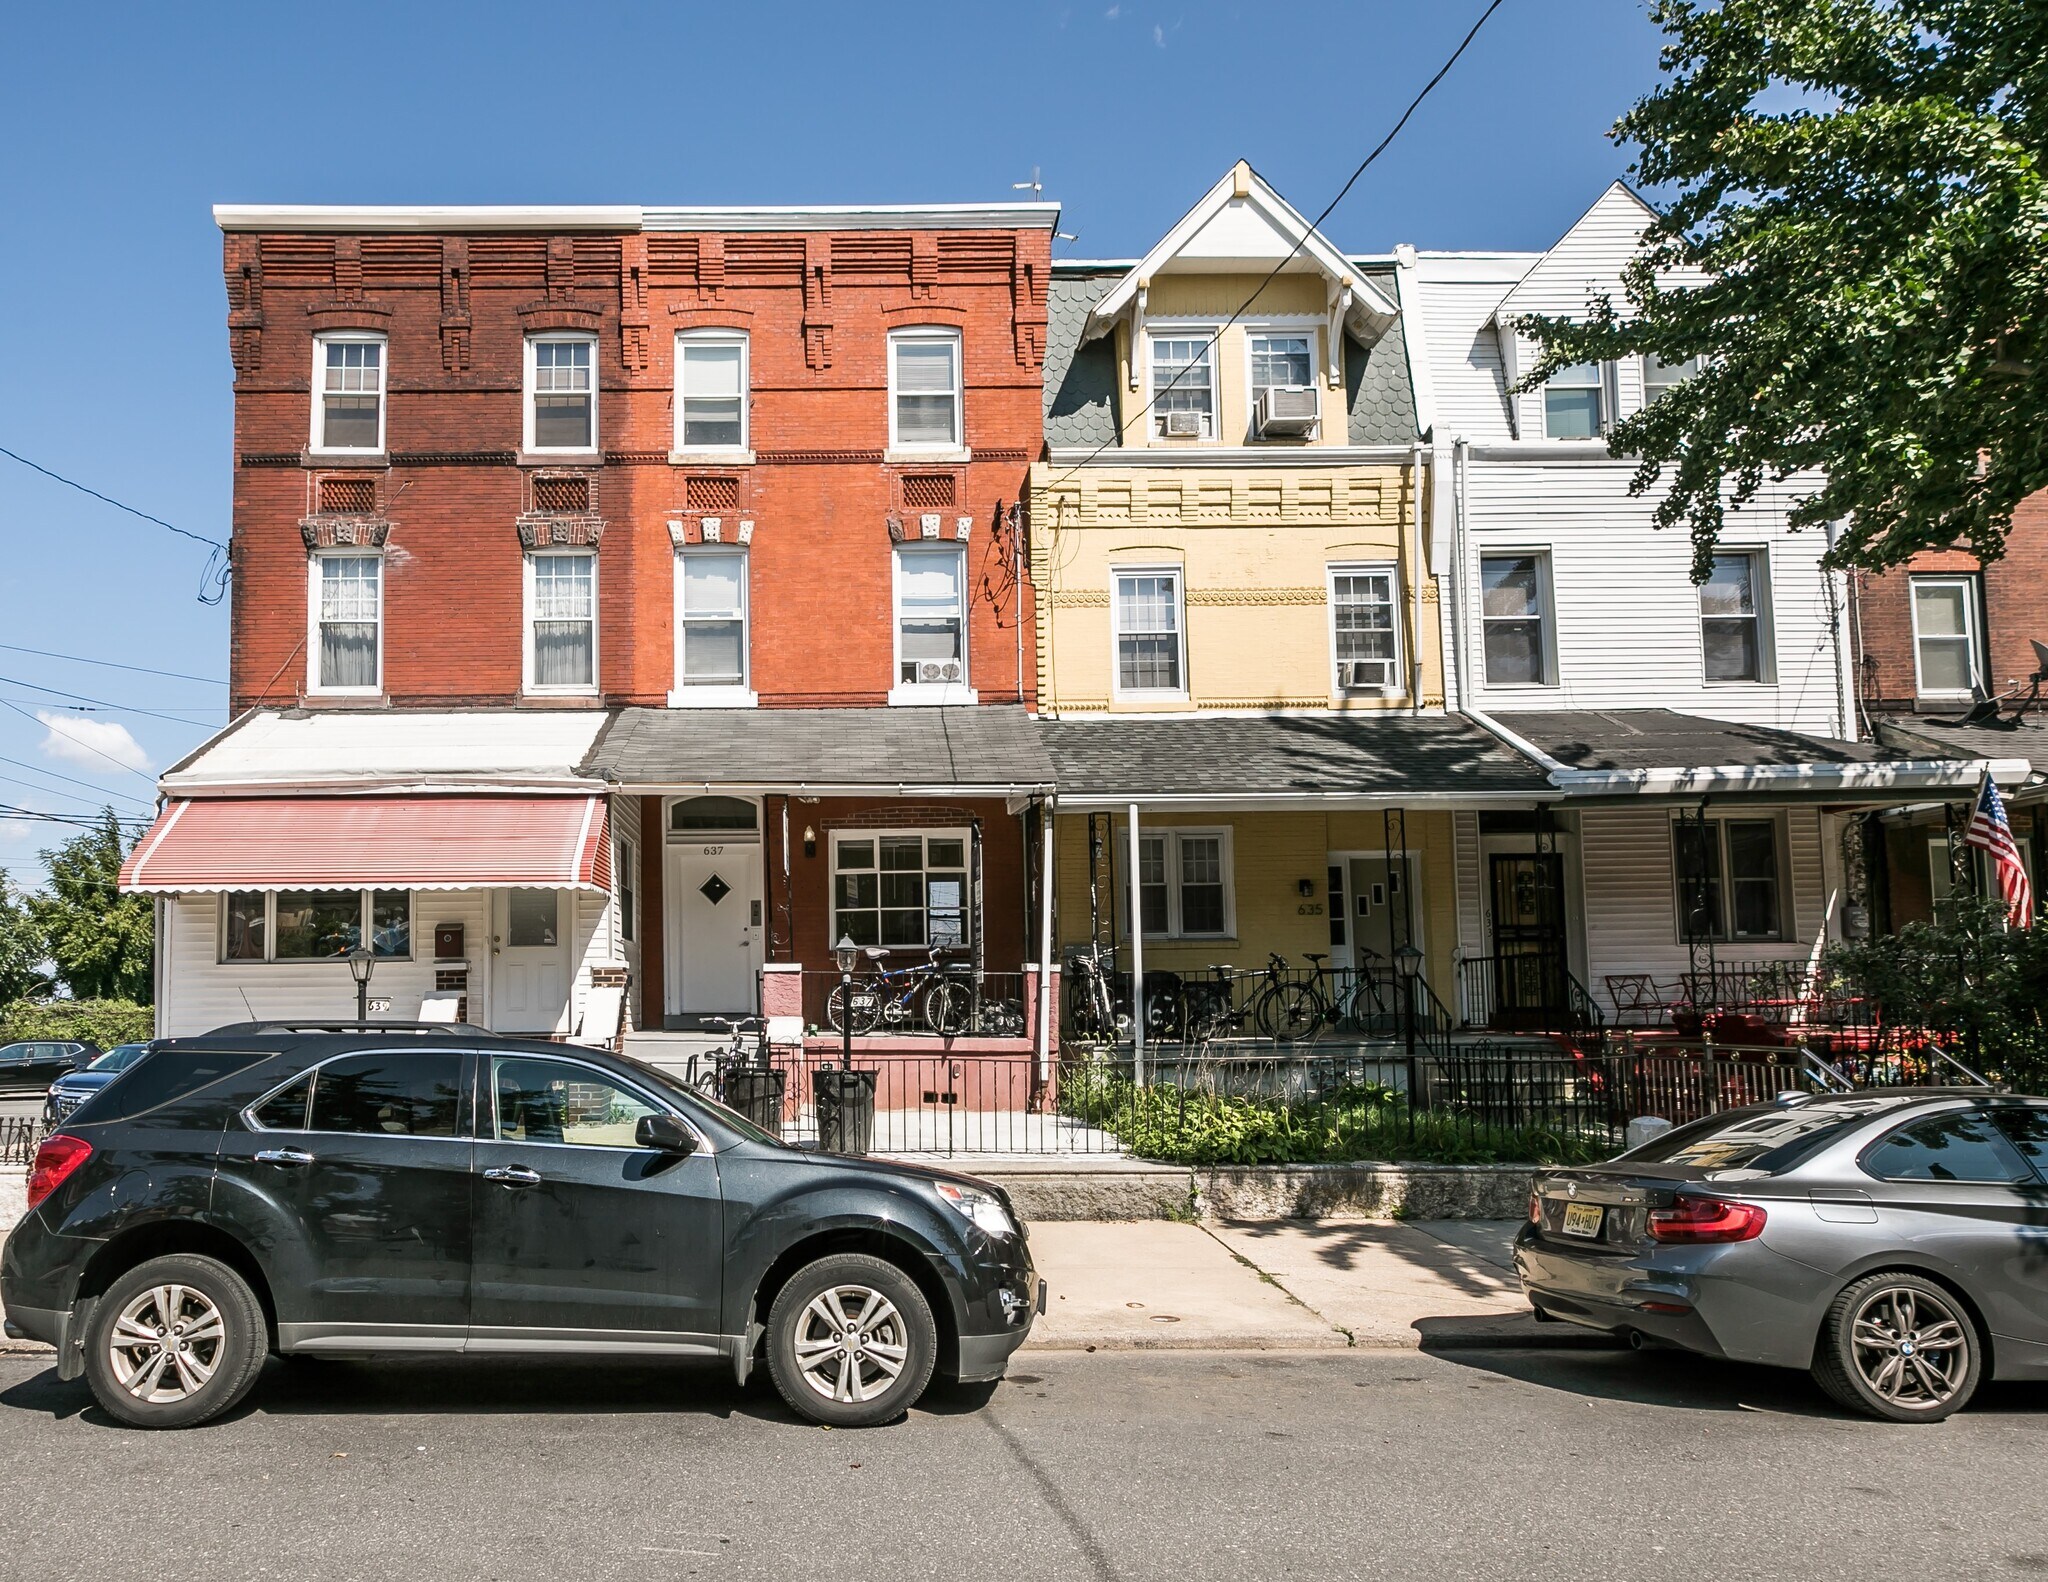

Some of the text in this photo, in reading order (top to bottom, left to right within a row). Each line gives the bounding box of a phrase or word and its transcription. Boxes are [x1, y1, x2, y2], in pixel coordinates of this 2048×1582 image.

[703, 846, 724, 856] 637
[1298, 904, 1323, 915] 635
[1485, 908, 1493, 938] 633
[852, 997, 873, 1006] 637
